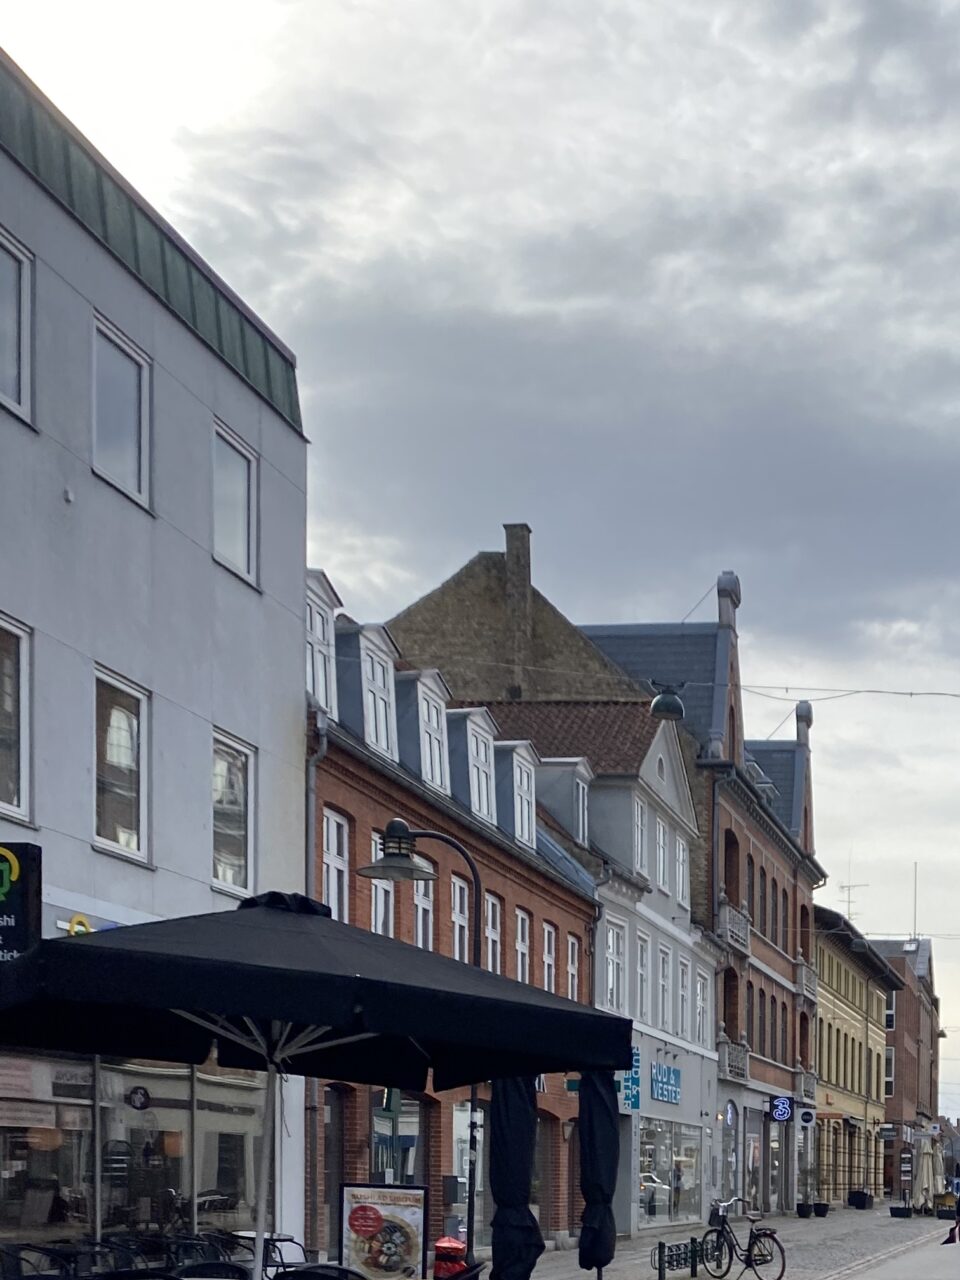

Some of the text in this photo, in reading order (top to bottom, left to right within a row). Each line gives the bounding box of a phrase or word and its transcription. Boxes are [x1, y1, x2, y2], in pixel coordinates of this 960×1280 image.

[651, 1060, 676, 1085] RUD &
[652, 1081, 681, 1105] VESTER
[773, 1097, 791, 1120] 3
